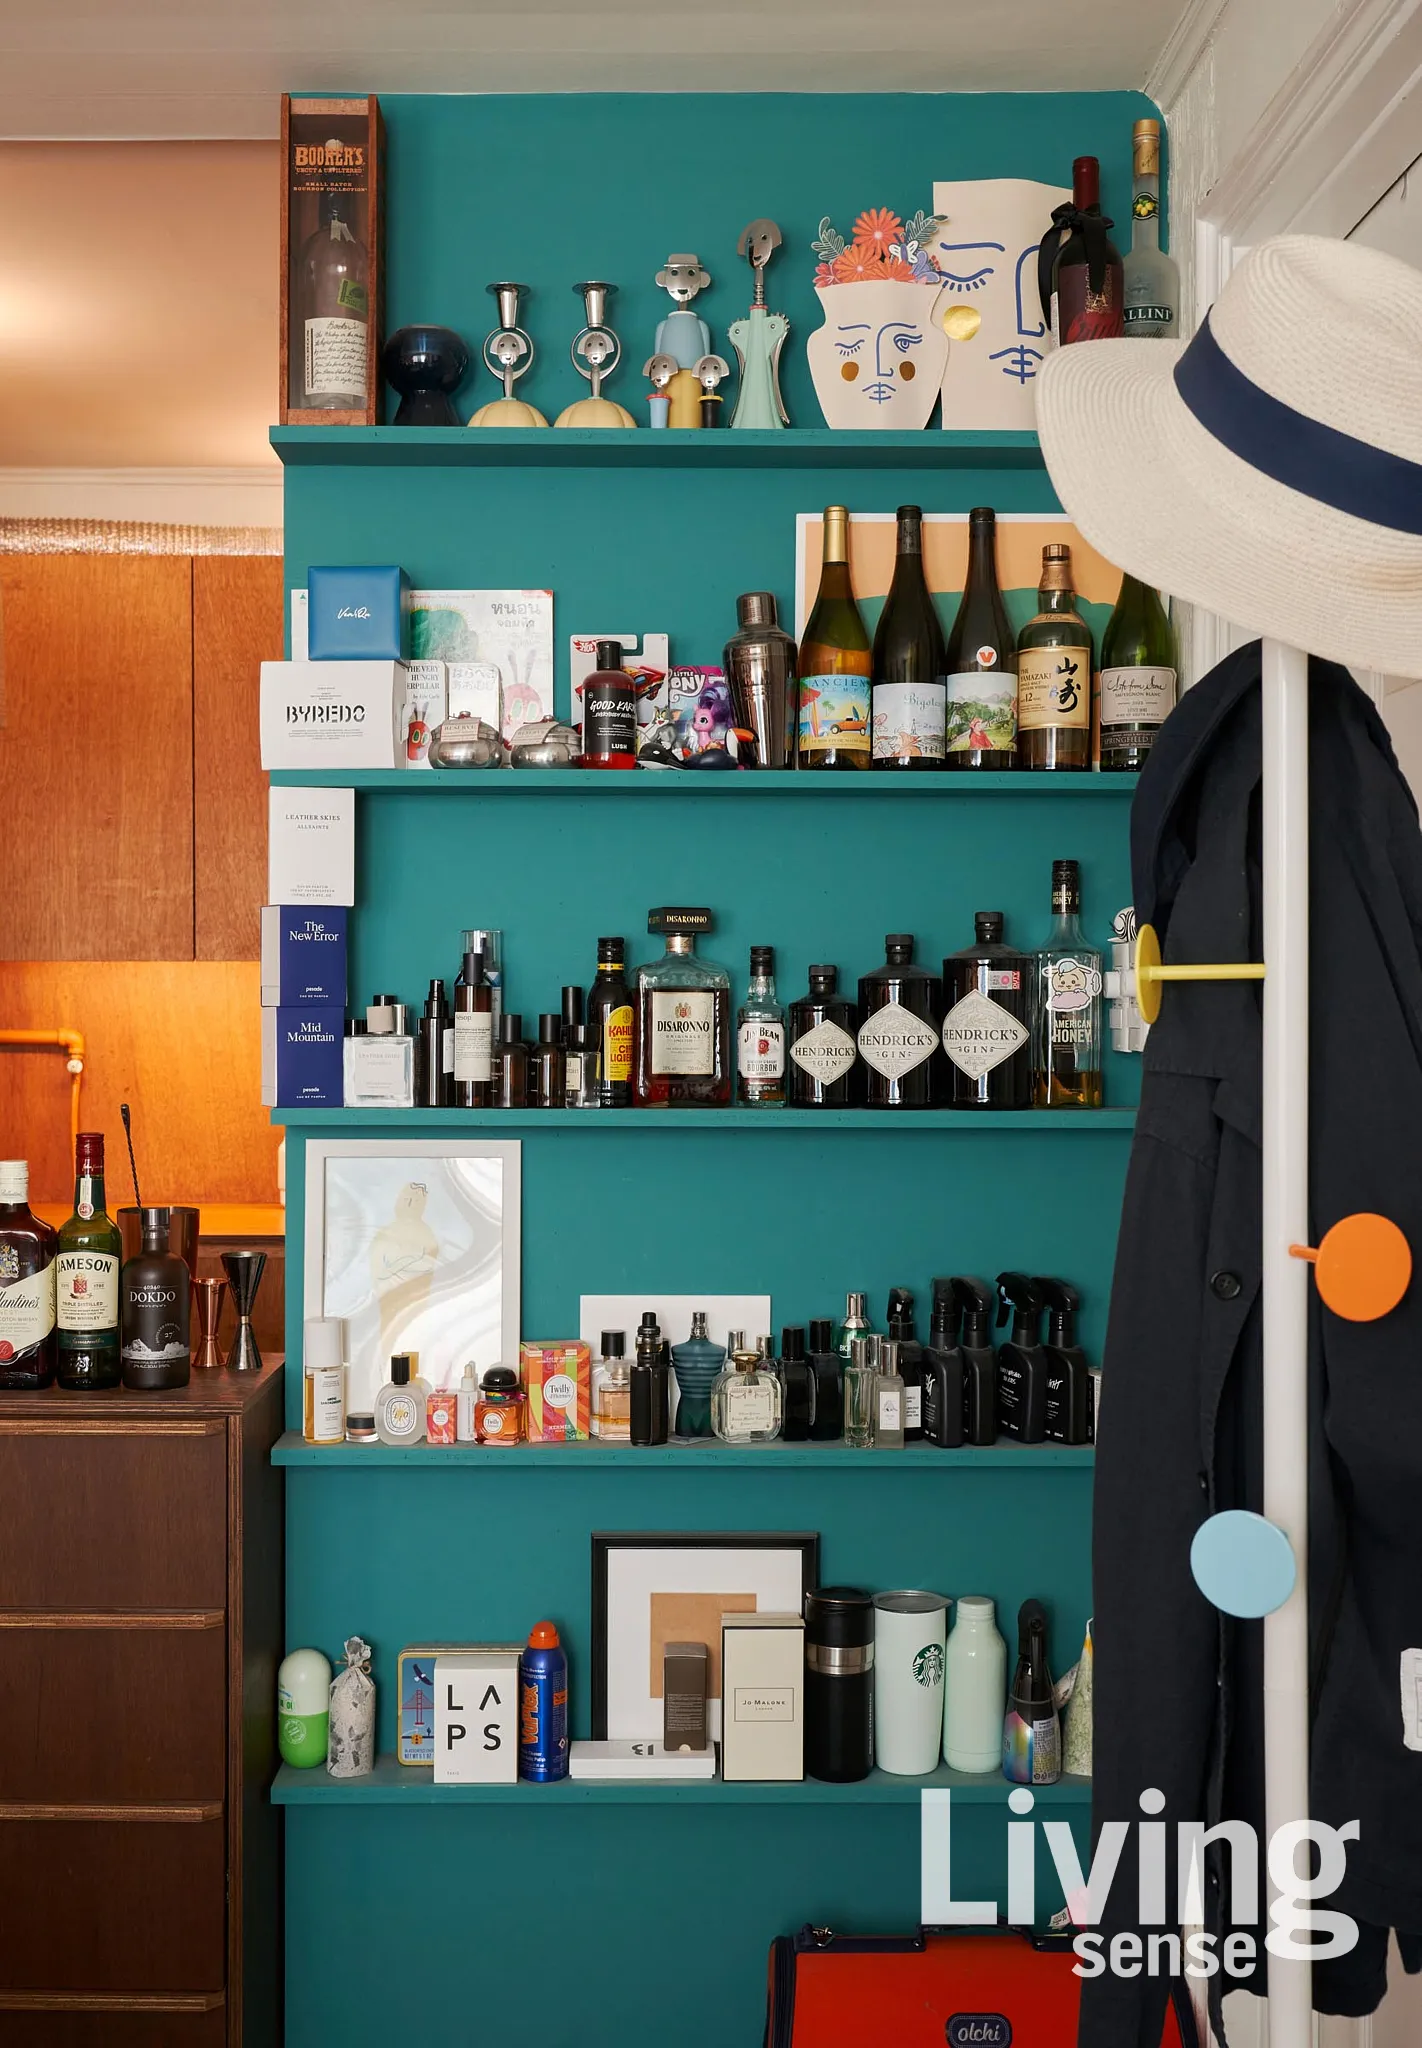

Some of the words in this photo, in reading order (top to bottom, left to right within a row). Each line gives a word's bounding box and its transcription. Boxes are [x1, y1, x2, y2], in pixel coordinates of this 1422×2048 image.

[1122, 308, 1170, 321] LLINI
[421, 665, 439, 673] VERY
[1025, 693, 1033, 702] 12
[589, 700, 616, 712] GOOD
[286, 705, 366, 723] BYREDO
[666, 915, 708, 924] DISARONNO
[304, 920, 325, 932] The
[289, 930, 313, 941] New
[313, 931, 339, 941] Error
[300, 1022, 322, 1033] Mid
[657, 1020, 710, 1033] DISARONNO
[1053, 1019, 1092, 1029] AMERICAN
[287, 1031, 335, 1042] Mountain
[759, 1027, 780, 1042] BEAM
[943, 1029, 1019, 1041] HENDRICK'S
[1053, 1029, 1093, 1043] HONEY
[859, 1035, 933, 1046] HENDRICK'S
[795, 1047, 856, 1056] HENDRICK'S
[881, 1050, 907, 1059] GIN
[963, 1045, 989, 1054] GIN
[747, 1063, 778, 1072] BOURBON
[817, 1059, 838, 1067] GIN
[57, 1258, 112, 1274] JAMESON
[129, 1290, 176, 1303] DOKDO
[550, 1384, 571, 1395] Twilly
[486, 1418, 500, 1426] Twilly
[957, 2022, 1000, 2042] olchi
